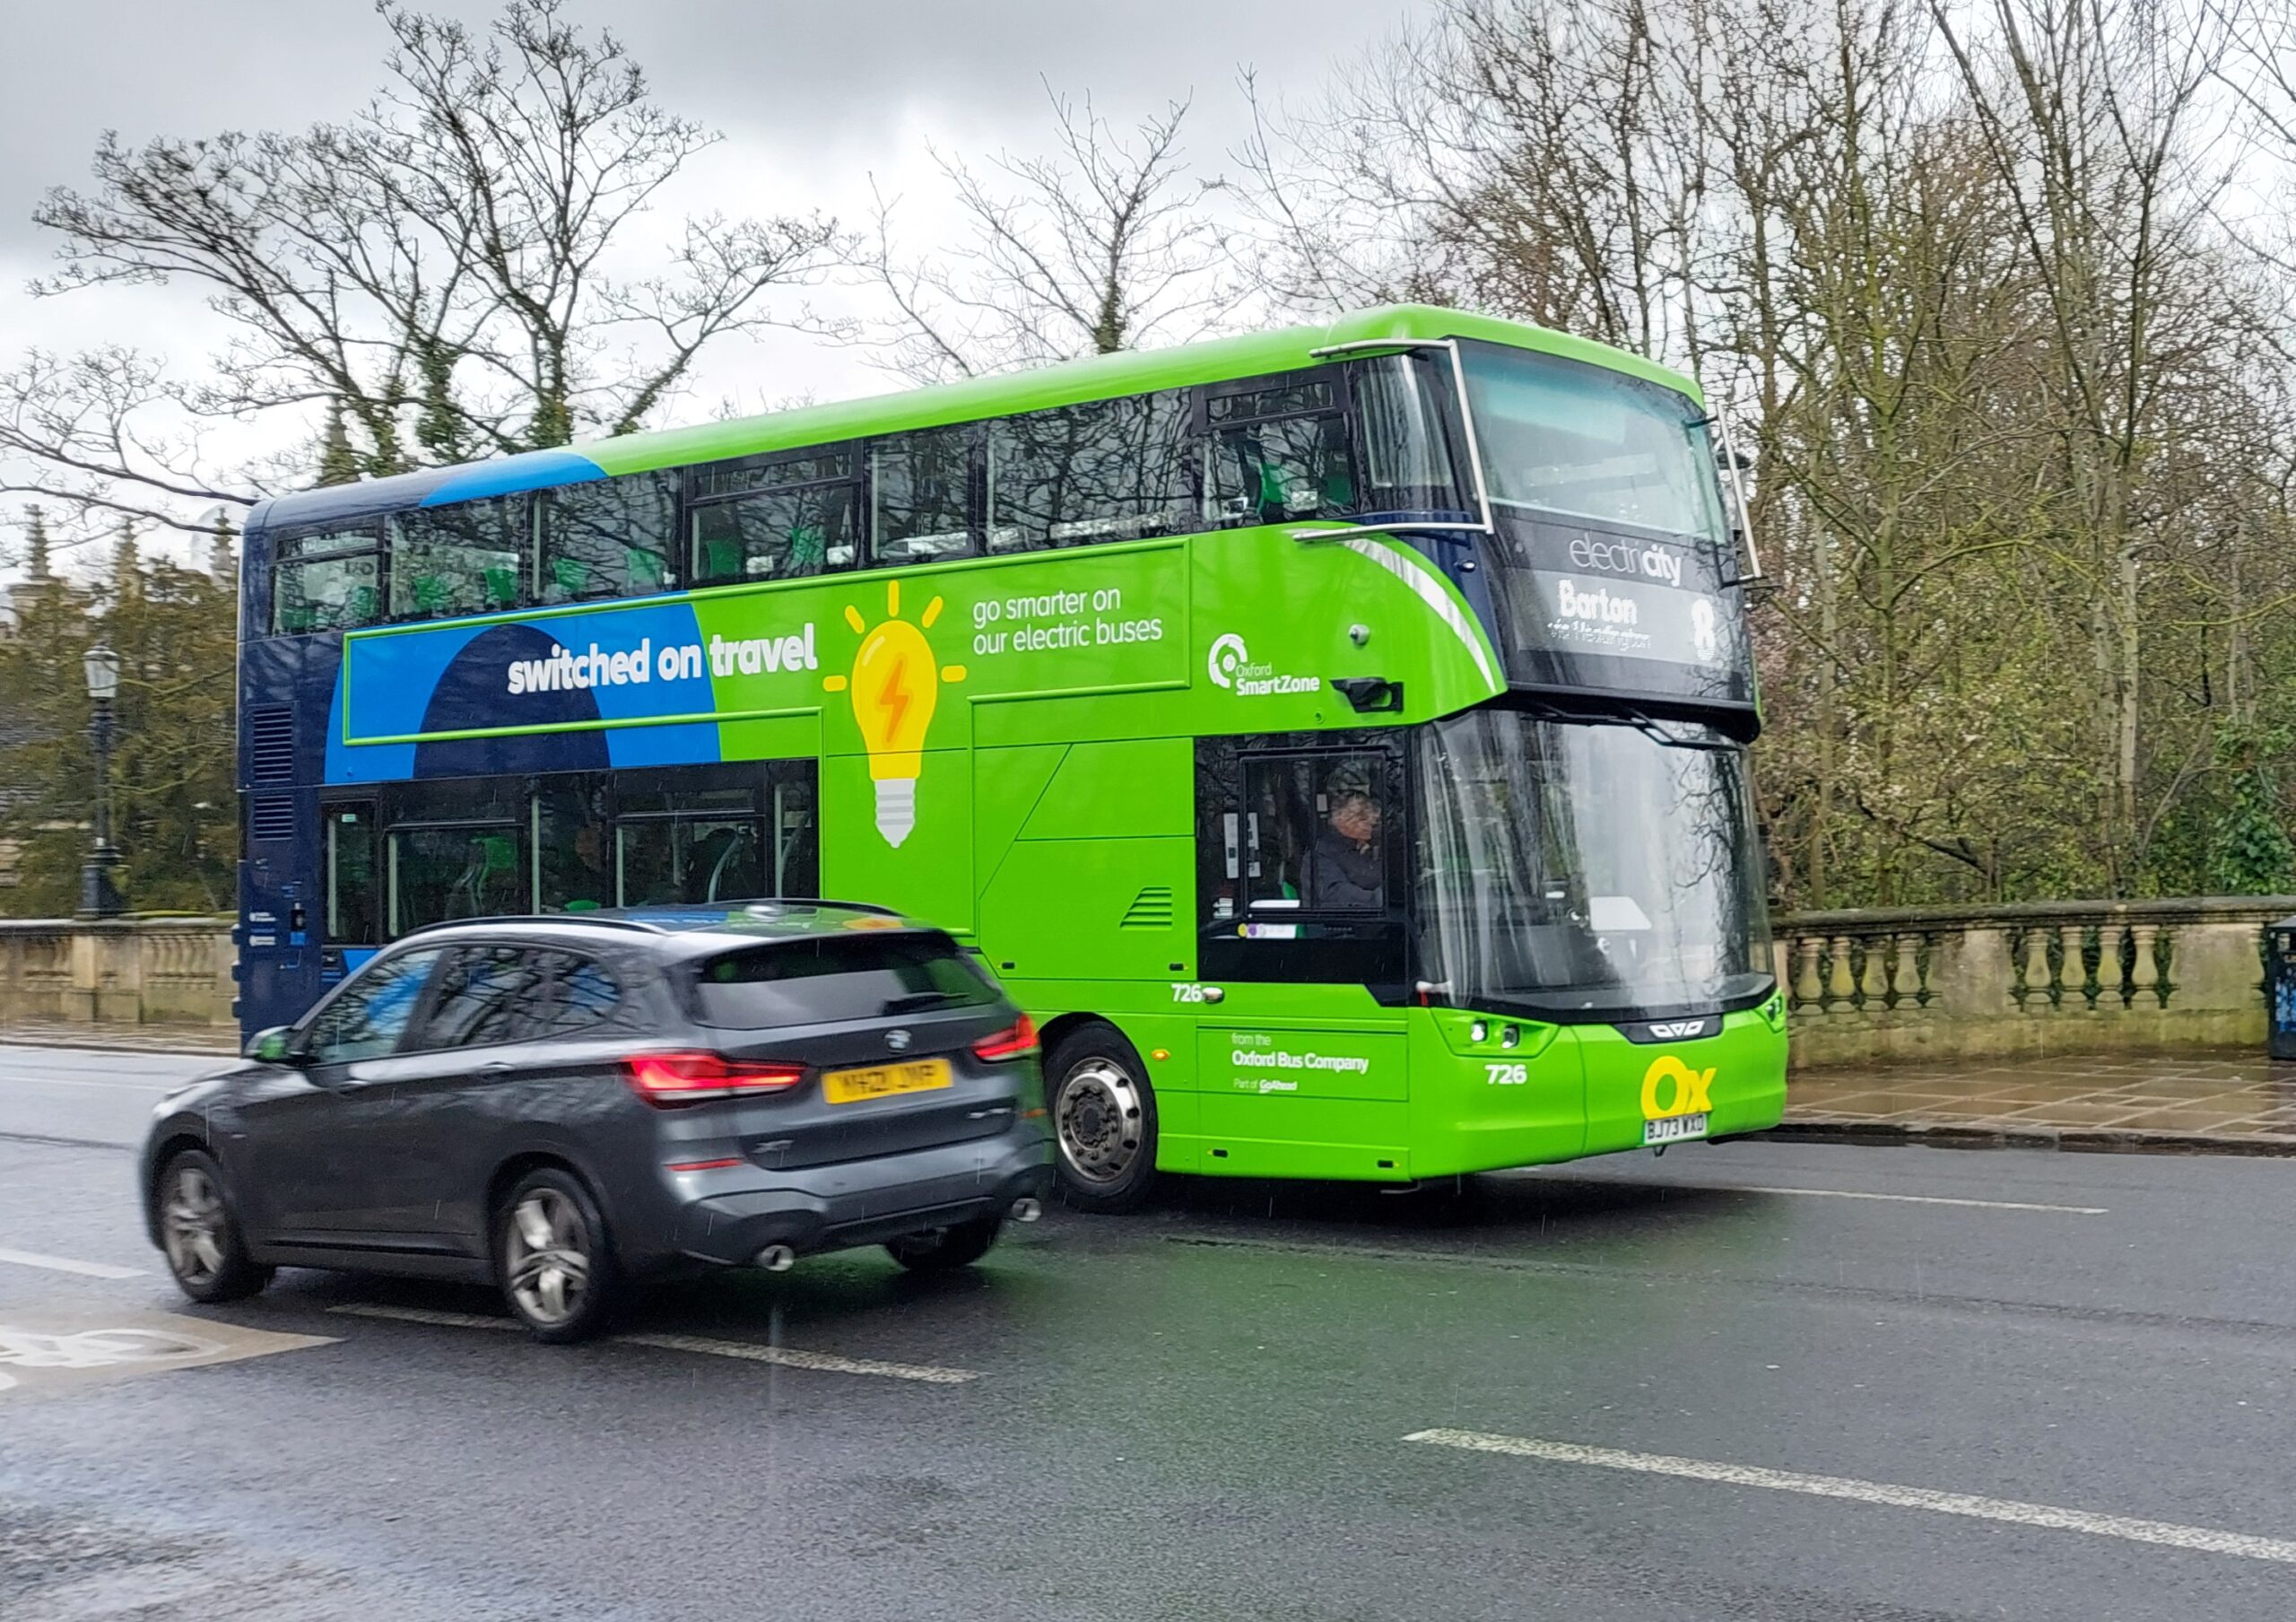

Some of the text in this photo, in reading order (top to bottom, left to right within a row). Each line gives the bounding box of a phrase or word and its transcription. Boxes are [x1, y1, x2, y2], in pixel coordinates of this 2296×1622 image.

[972, 588, 1121, 630] go smarter on
[1559, 579, 1638, 625] Barton
[972, 616, 1163, 656] our electric buses
[1692, 597, 1717, 661] 8
[508, 623, 818, 694] switched on travel
[1236, 662, 1272, 677] Oxford
[1236, 675, 1320, 696] SmartZone
[1171, 984, 1203, 1002] 726
[1231, 1033, 1272, 1046] from the
[1231, 1050, 1369, 1074] Oxford Bus Company
[1484, 1064, 1527, 1085] 726
[1641, 1056, 1717, 1121] Ox
[1647, 1118, 1680, 1140] BJ73
